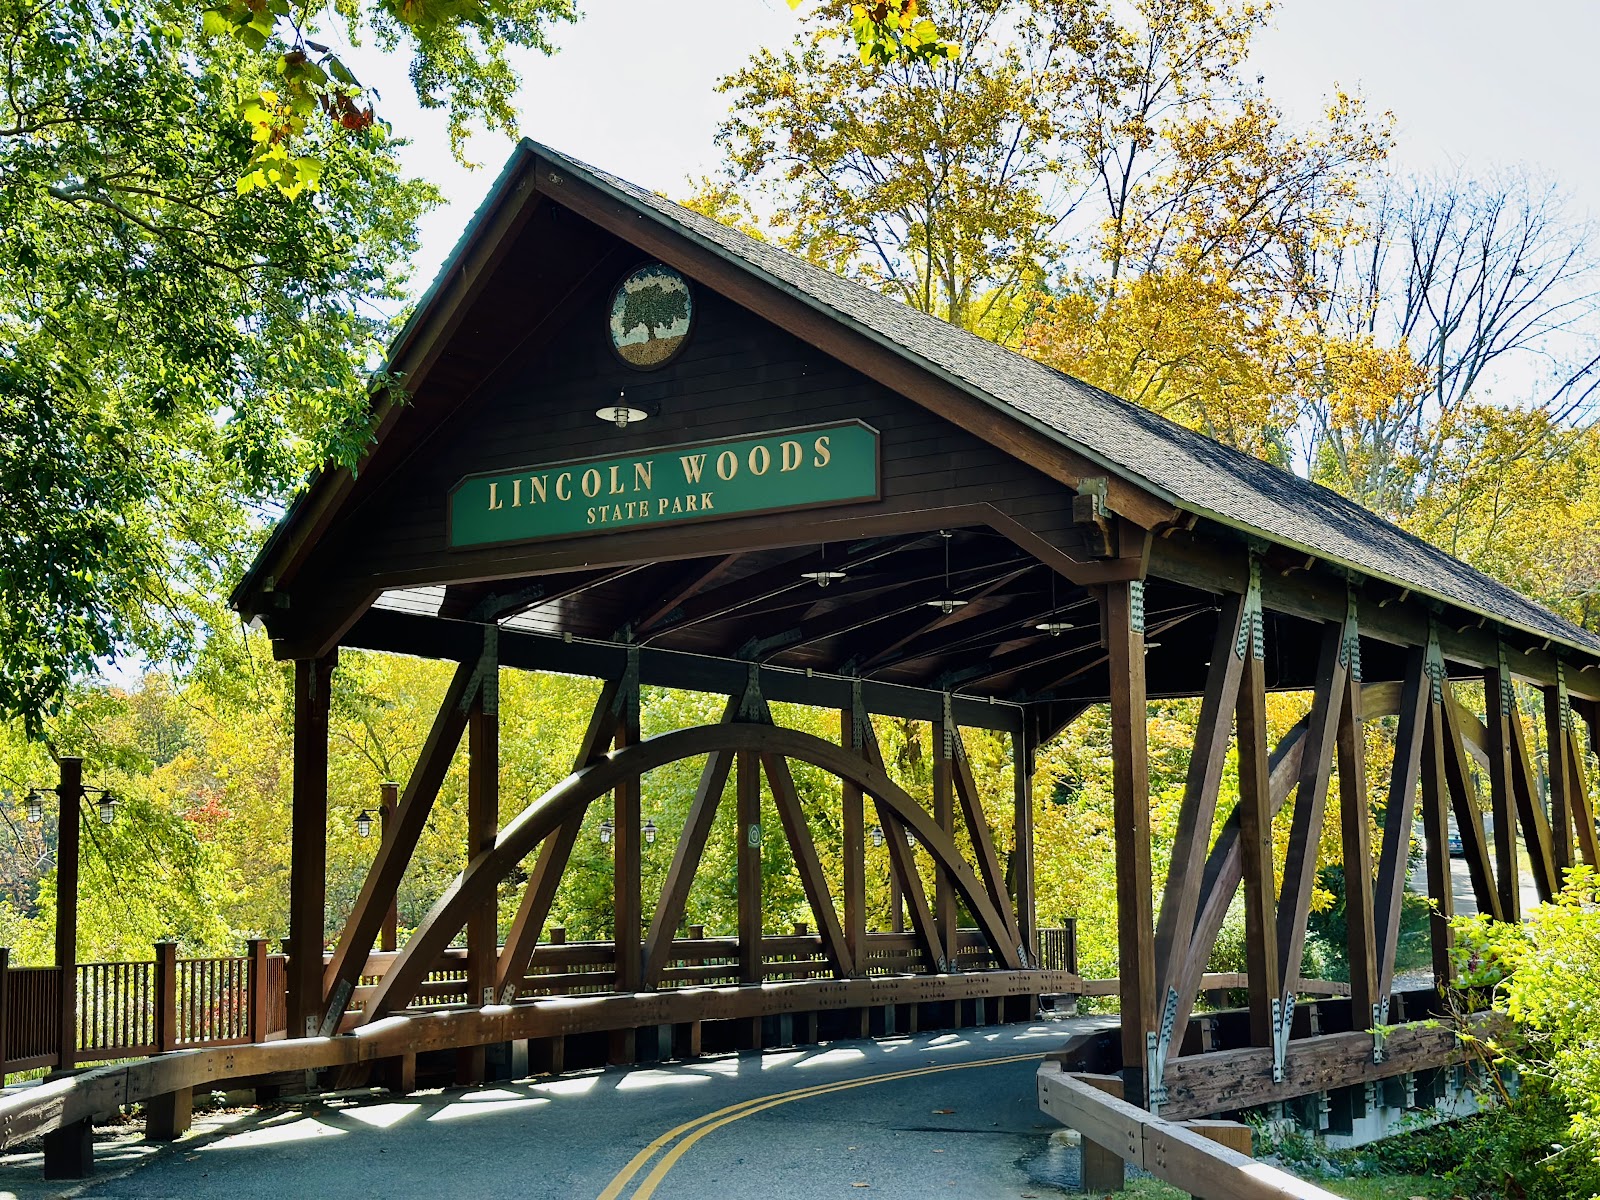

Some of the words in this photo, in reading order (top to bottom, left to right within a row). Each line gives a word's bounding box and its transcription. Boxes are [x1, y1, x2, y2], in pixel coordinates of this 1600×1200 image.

[488, 461, 654, 511] LINCOLN
[679, 436, 832, 485] WOODS
[586, 500, 650, 525] STATE
[658, 492, 715, 516] PARK
